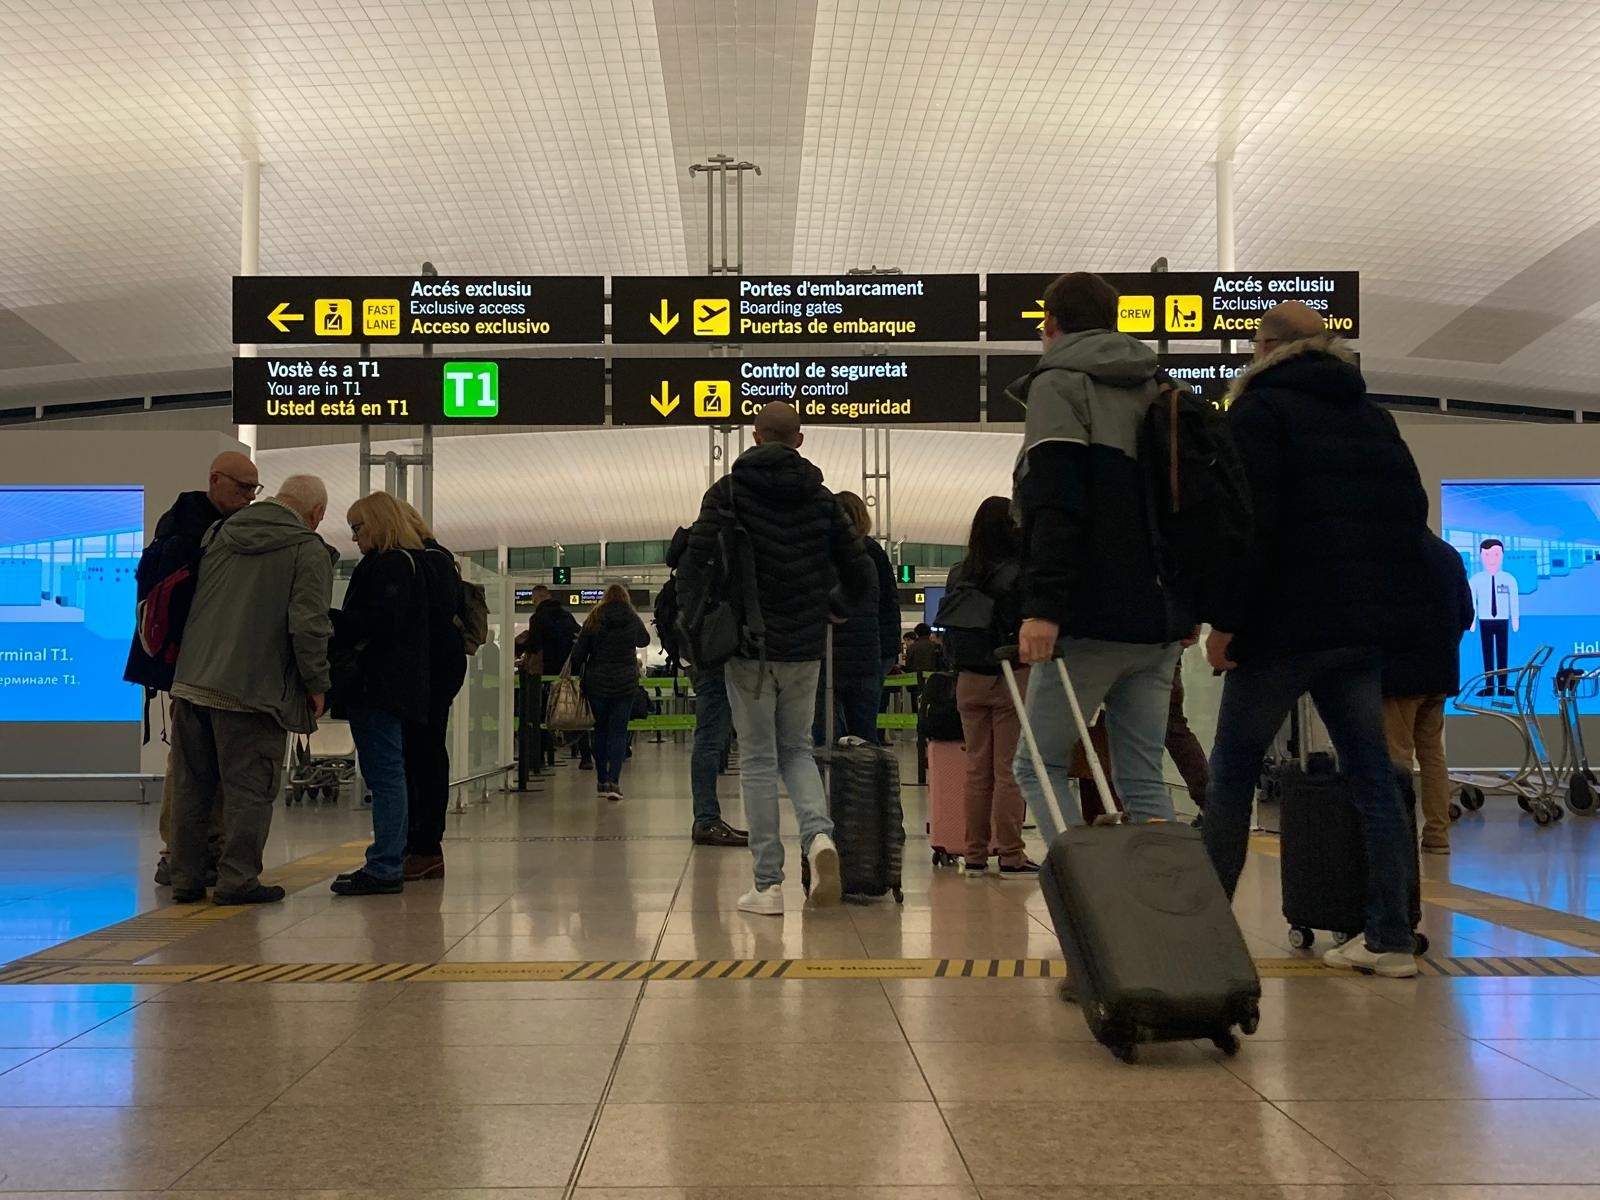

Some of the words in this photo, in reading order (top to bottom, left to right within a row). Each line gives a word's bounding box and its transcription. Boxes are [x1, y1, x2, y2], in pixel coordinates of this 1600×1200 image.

[411, 281, 460, 297] Accés
[466, 281, 532, 297] exclusiu
[740, 281, 792, 297] Portes
[797, 281, 924, 297] d'embarcament
[1213, 275, 1262, 292] Accés
[1268, 277, 1335, 292] exclusiu
[368, 306, 395, 315] FAST
[410, 301, 474, 315] Exclusive
[479, 304, 526, 315] access
[741, 301, 802, 317] Boarding
[806, 301, 843, 316] gates
[1213, 297, 1277, 311] Exclusive
[1120, 309, 1151, 319] CREW
[366, 319, 396, 329] LANE
[411, 319, 469, 335] Acceso
[475, 319, 551, 334] exclusivo
[740, 319, 802, 334] Puertas
[807, 318, 828, 334] de
[833, 318, 916, 336] embarque
[267, 361, 313, 378] Vostè
[318, 361, 338, 378] és
[343, 365, 353, 378] a
[359, 361, 380, 378] T1
[741, 362, 800, 378] Control
[805, 362, 826, 378] de
[831, 362, 908, 380] seguretat
[267, 381, 292, 396] You
[297, 385, 321, 396] are
[325, 382, 338, 396] in
[343, 382, 361, 396] T1
[446, 371, 497, 408] T1
[741, 382, 797, 398] Security
[801, 382, 849, 396] control
[266, 399, 315, 416] Usted
[320, 399, 355, 416] está
[361, 404, 382, 416] en
[387, 399, 409, 416] T1
[805, 400, 826, 415] de
[831, 399, 911, 418] seguridad
[50, 648, 73, 661] T1.
